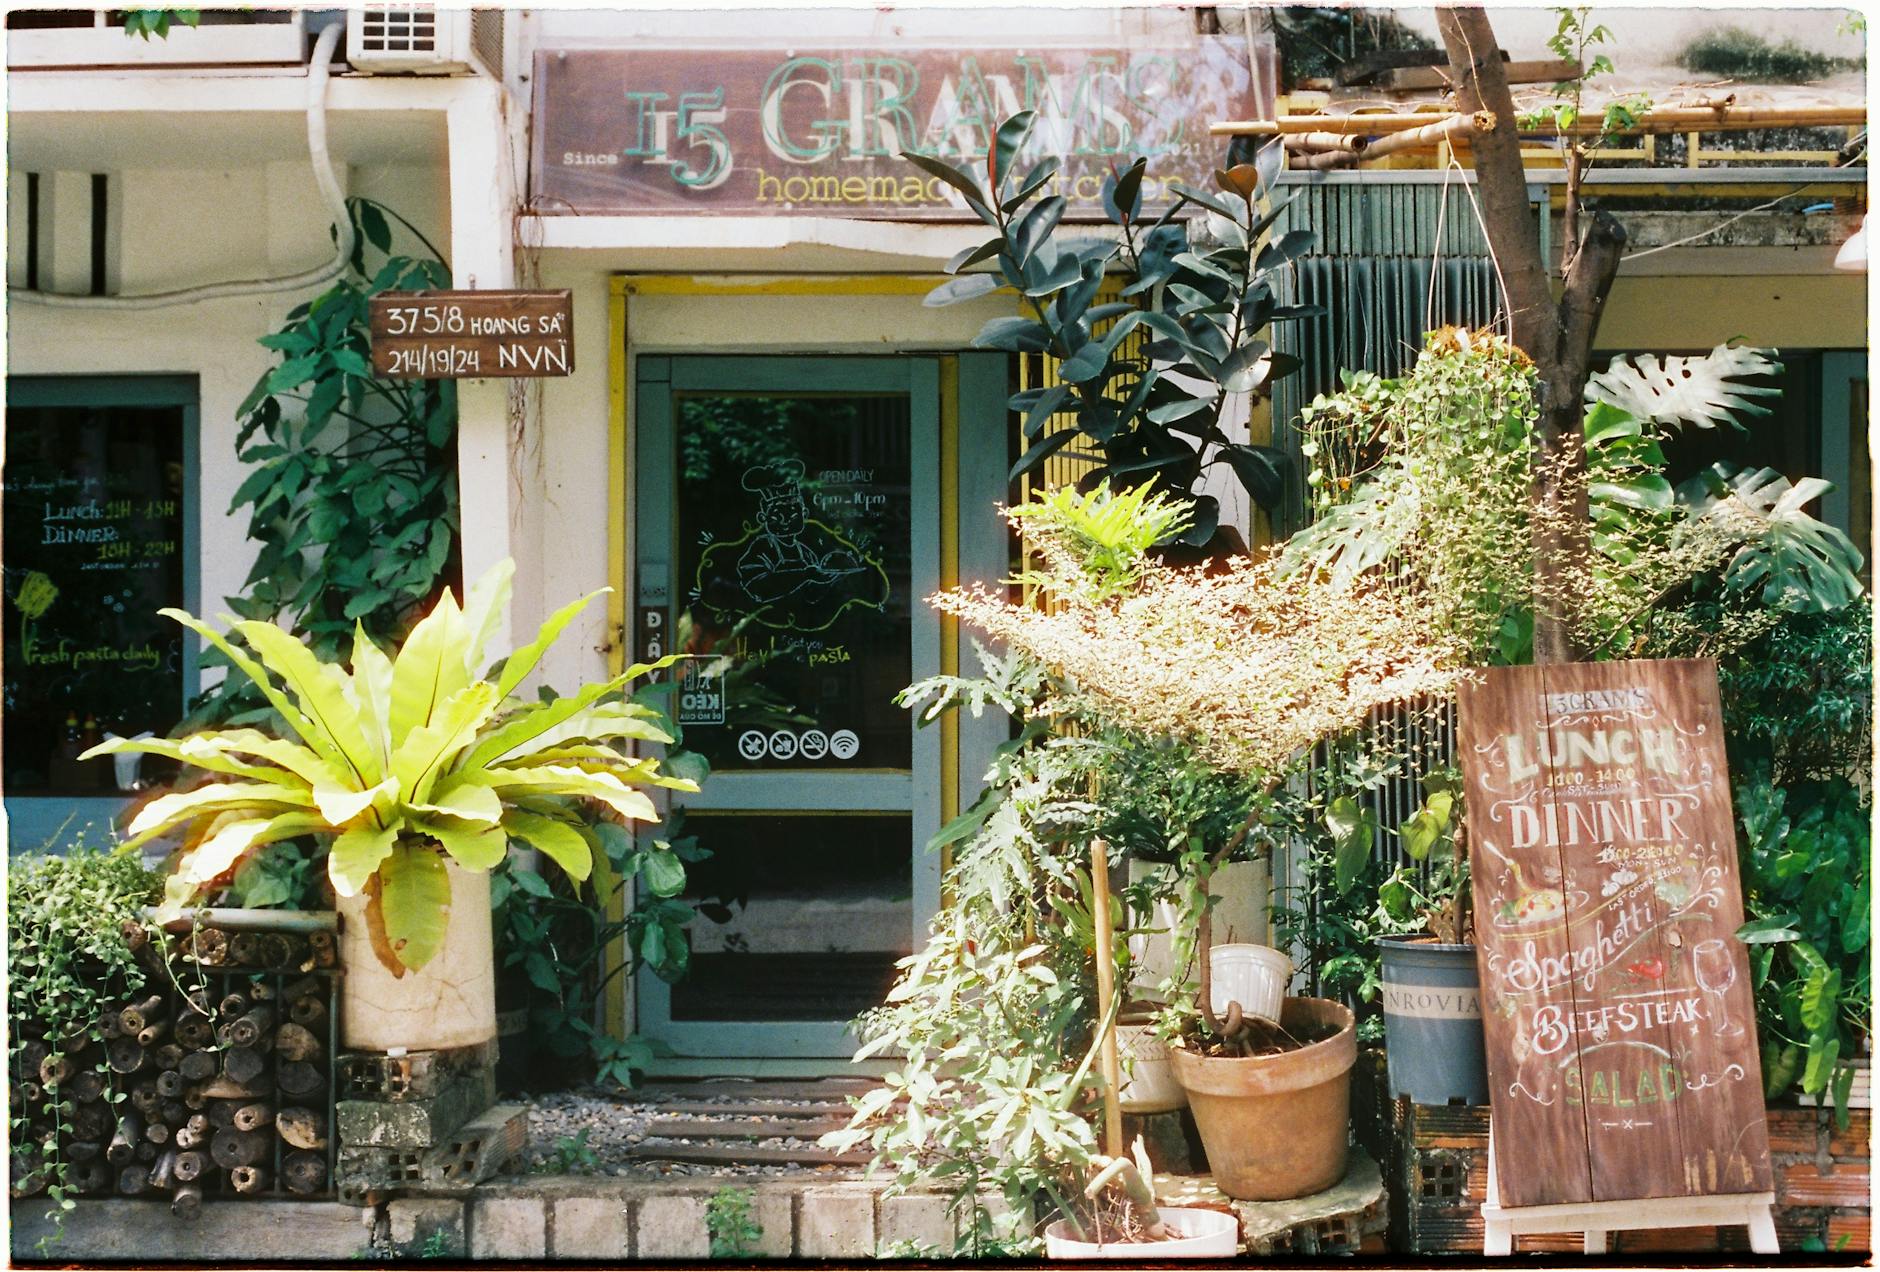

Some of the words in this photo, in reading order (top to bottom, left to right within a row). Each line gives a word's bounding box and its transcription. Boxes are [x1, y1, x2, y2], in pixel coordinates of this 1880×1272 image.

[760, 56, 1185, 165] GRAMS
[563, 152, 618, 165] Since
[757, 168, 956, 202] homema
[387, 306, 465, 335] 375/8
[470, 316, 530, 335] HOANG
[388, 343, 479, 376] 214/19/24
[819, 470, 846, 483] OPEN
[847, 469, 874, 482] DAILY
[813, 492, 842, 511] 6pm
[854, 491, 886, 511] 10pm
[1505, 729, 1680, 784] LUNCH
[1508, 799, 1689, 848] DINNER
[1502, 903, 1654, 997] Spaghetti
[1389, 991, 1479, 1012] NROVIA
[1532, 998, 1705, 1055] BEEFSTEAK
[1565, 1064, 1683, 1107] SALAD
